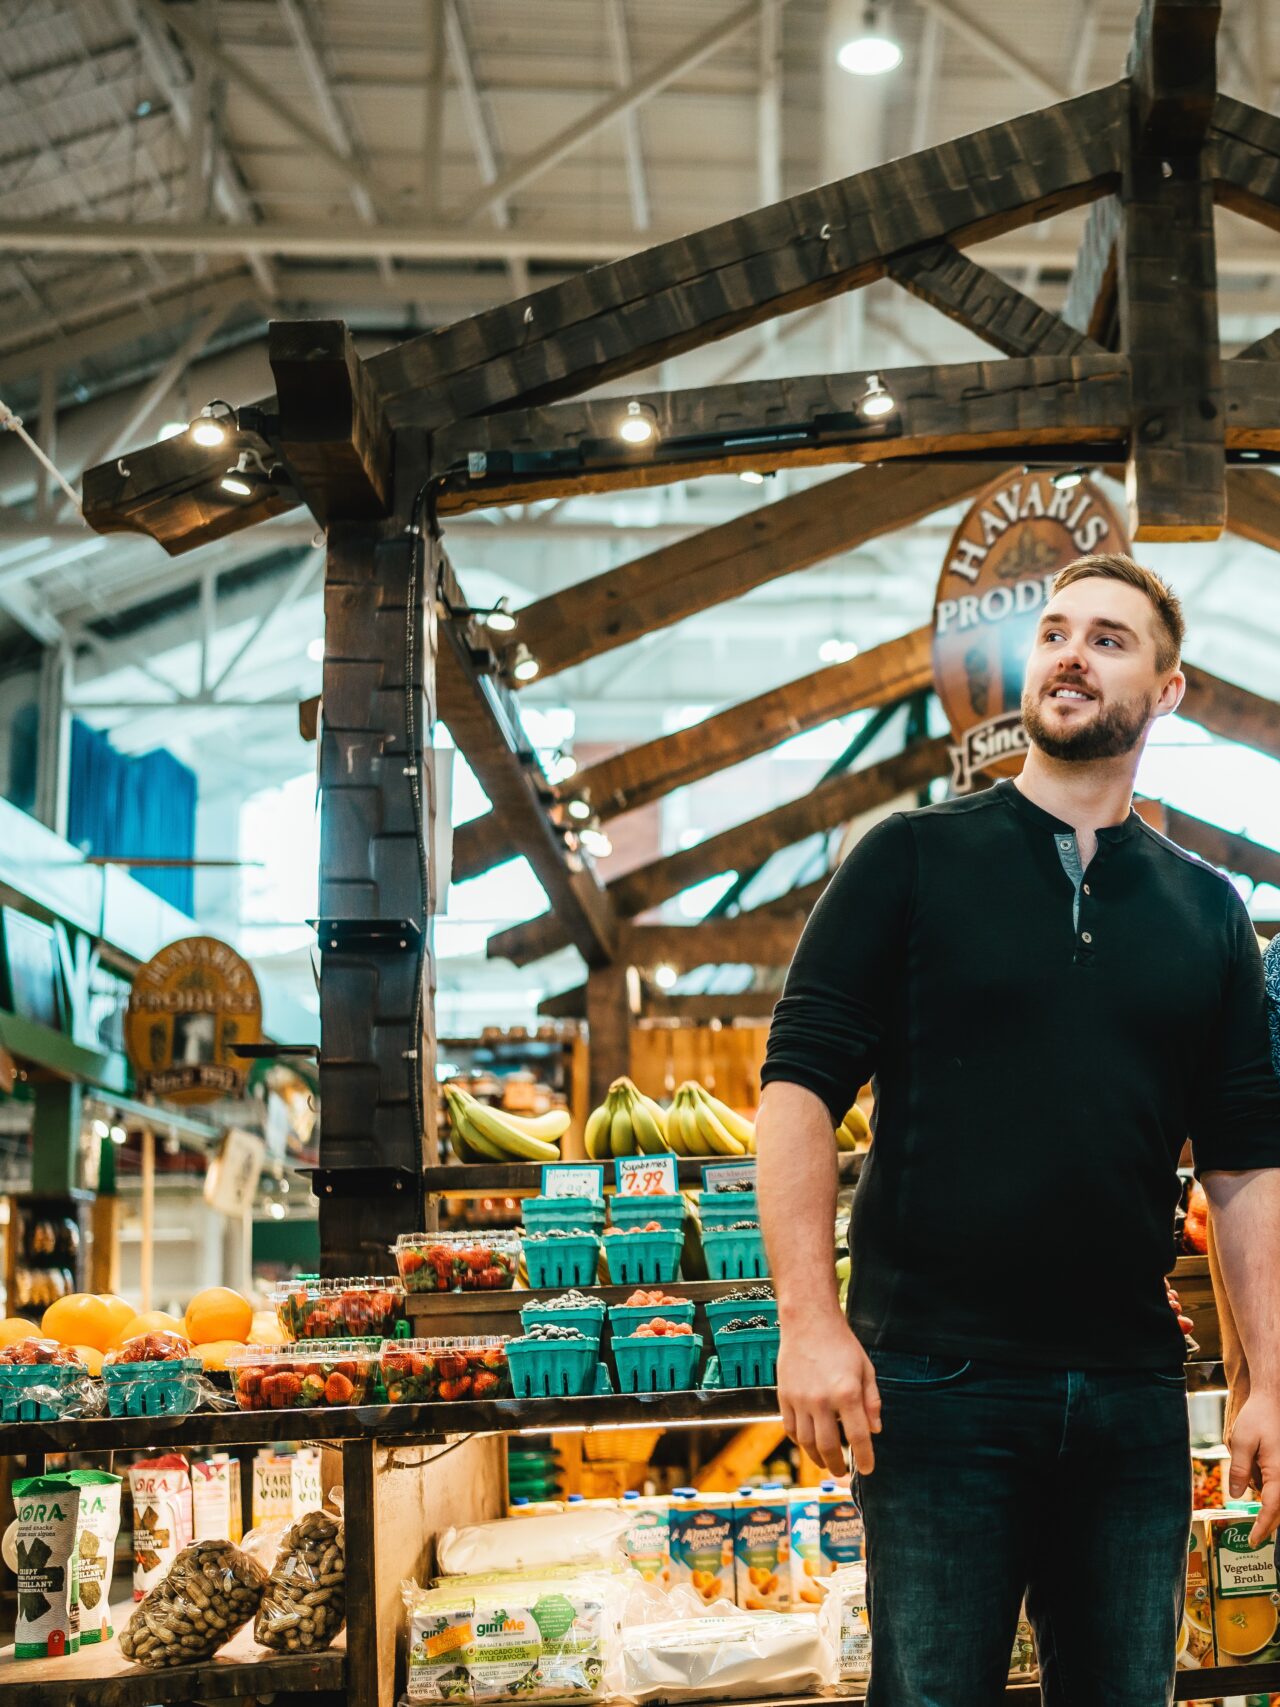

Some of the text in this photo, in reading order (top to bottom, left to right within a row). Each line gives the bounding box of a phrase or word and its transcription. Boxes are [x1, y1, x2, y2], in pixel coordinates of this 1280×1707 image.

[950, 481, 1109, 582] HAVARIS
[625, 1170, 664, 1191] 7.99
[135, 1478, 170, 1493] ORA
[681, 1522, 731, 1544] Almond
[737, 1518, 787, 1541] Almond
[1223, 1561, 1273, 1575] Vegetable
[1233, 1573, 1265, 1584] Broth
[477, 1618, 526, 1637] gimMe
[475, 1652, 530, 1663] HUILE D'AVOCAT
[479, 1648, 513, 1656] AVOCADO
